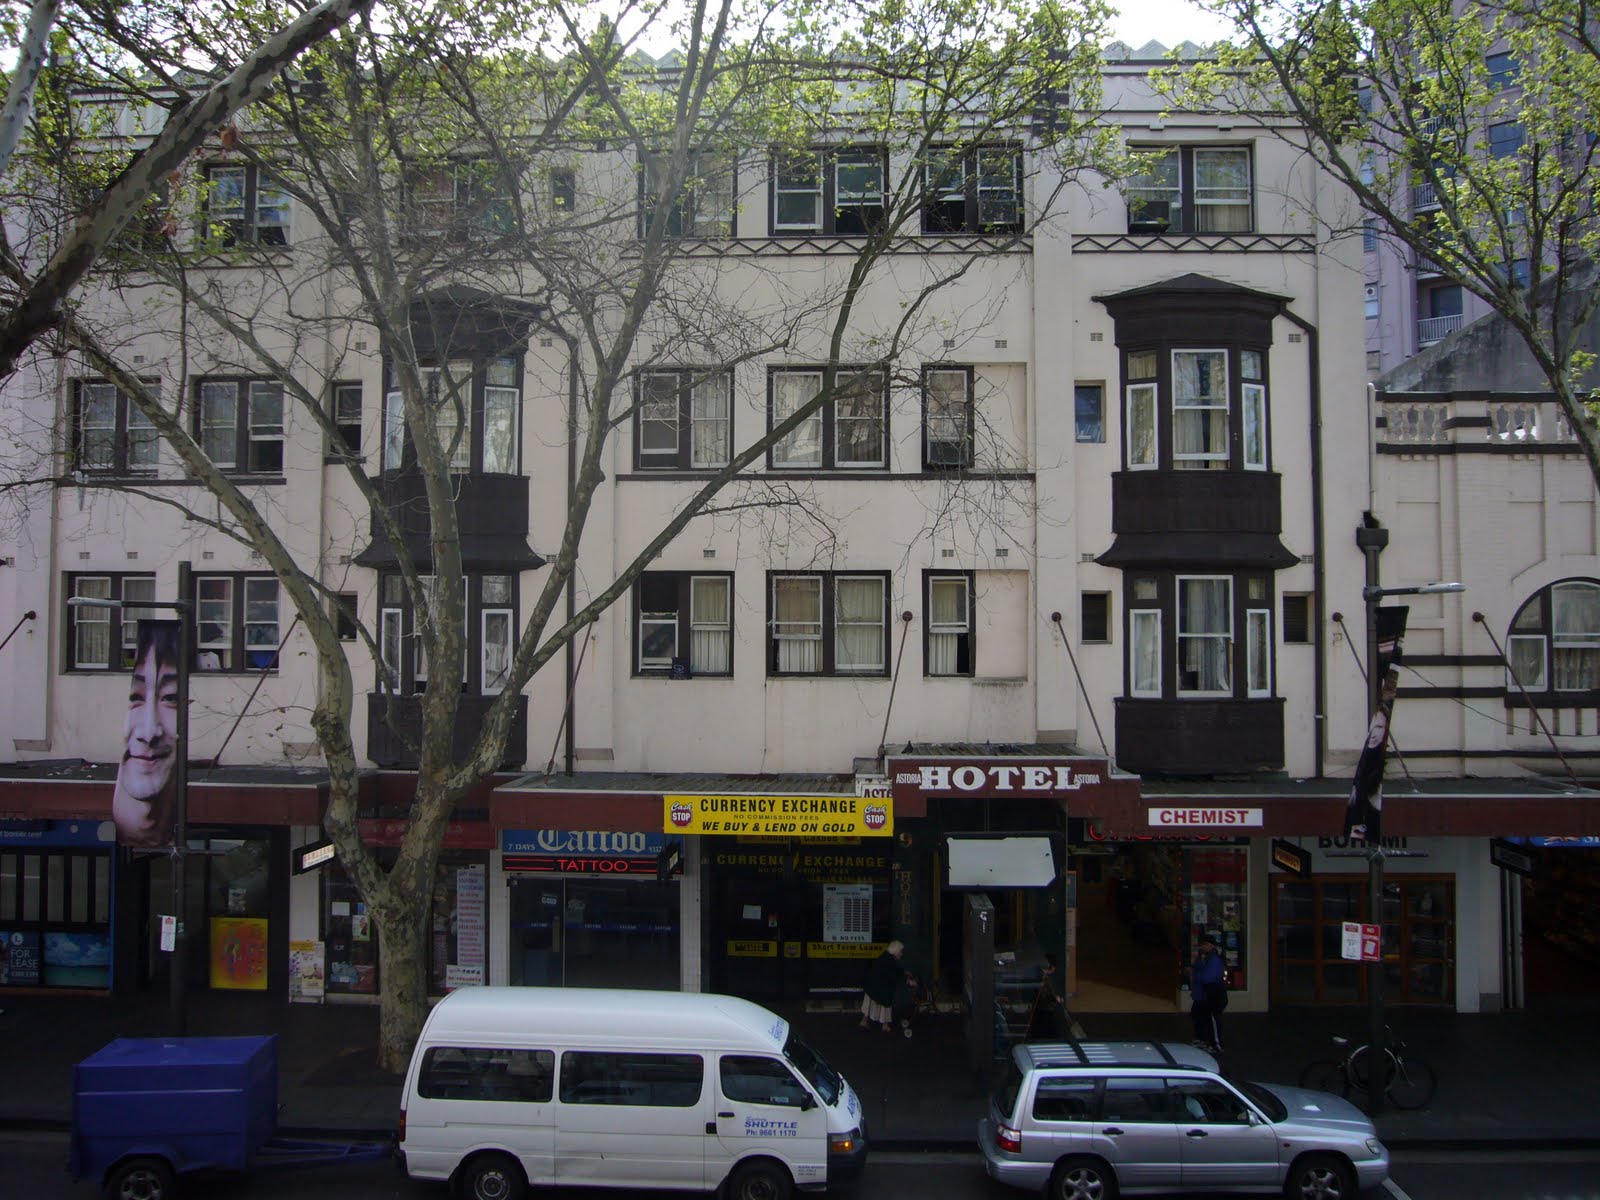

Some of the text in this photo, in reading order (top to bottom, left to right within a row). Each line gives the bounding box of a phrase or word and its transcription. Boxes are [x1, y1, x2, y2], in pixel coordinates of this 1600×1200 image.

[896, 766, 1100, 791] ASTORIA HOTEL ASTORIA
[671, 801, 693, 811] Cash
[700, 798, 857, 813] CURRENCY EXCHANGE
[864, 803, 887, 813] Cash
[672, 811, 692, 821] STOP
[865, 814, 886, 824] STOP
[1160, 810, 1249, 824] CHEMIST
[702, 821, 856, 833] WE BUY & LEND ON GOLD
[515, 843, 536, 851] DAYS
[556, 859, 629, 872] TATTOO
[804, 856, 887, 868] EXCHANGE
[812, 943, 834, 951] Short
[11, 948, 31, 959] FOR
[11, 959, 40, 969] LEASE
[744, 1121, 798, 1129] SHUTTLE
